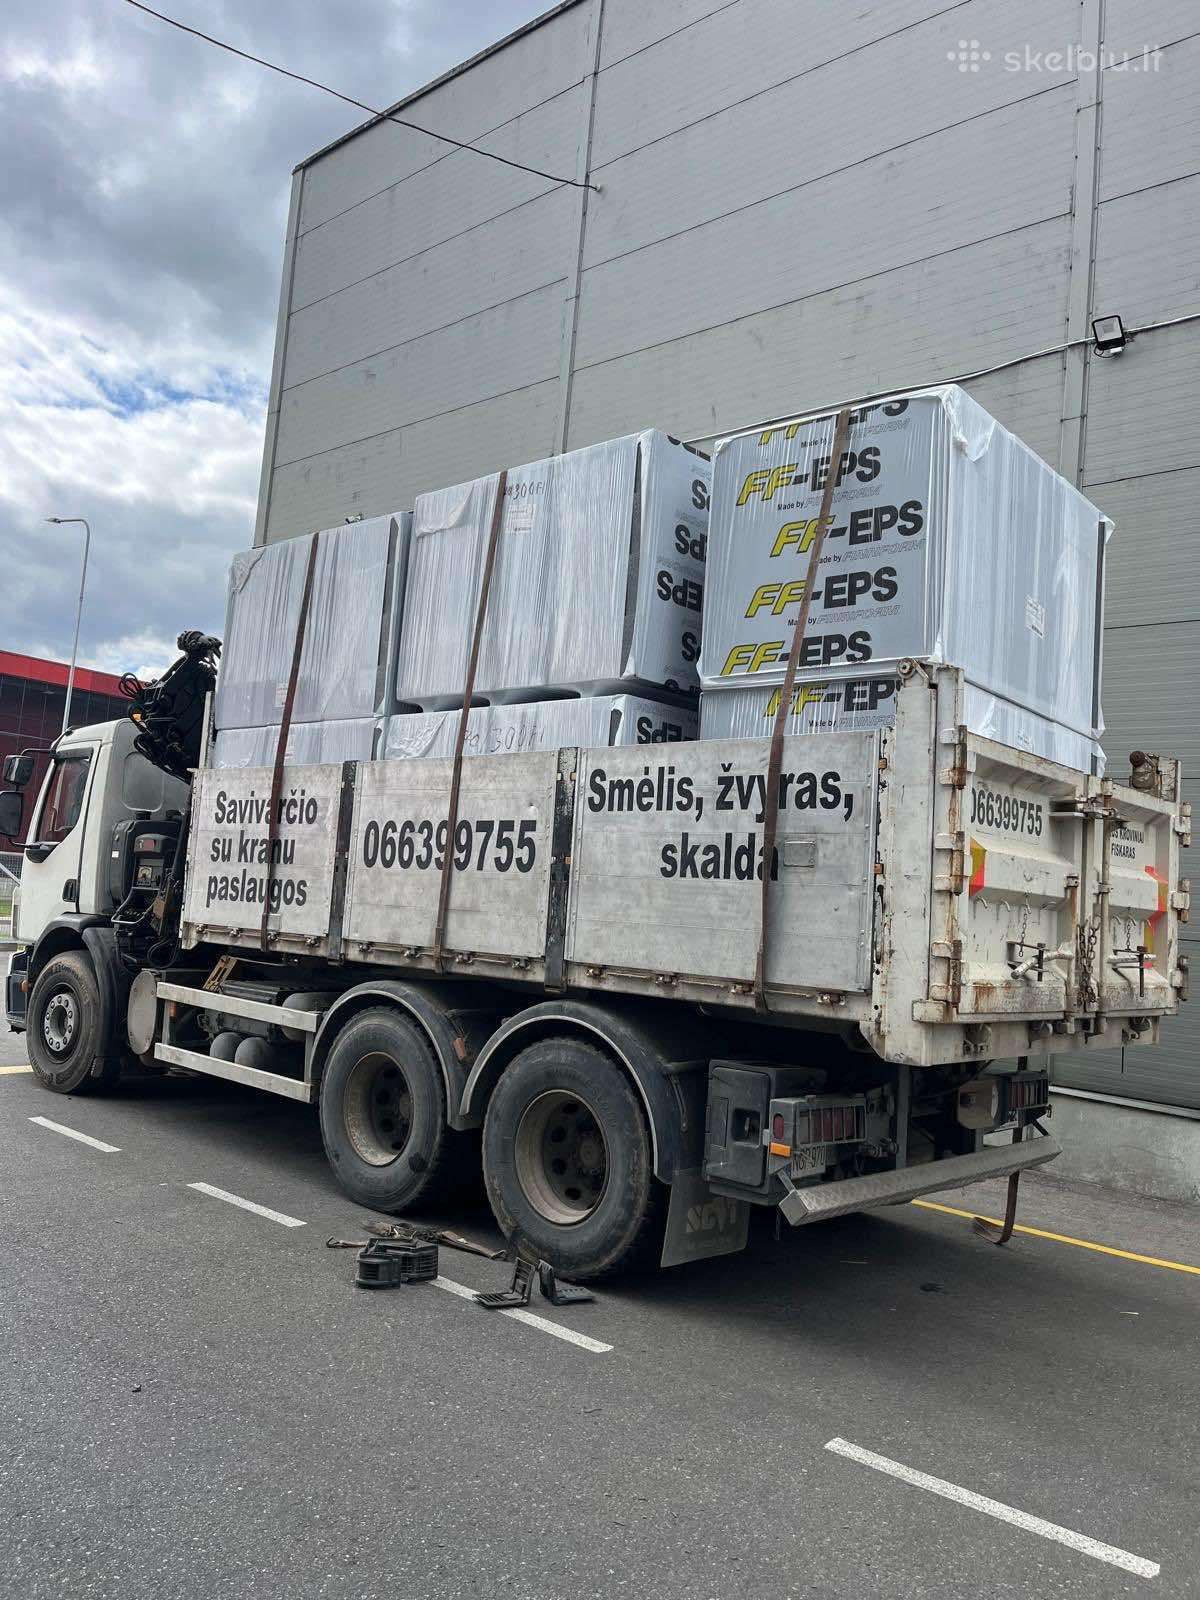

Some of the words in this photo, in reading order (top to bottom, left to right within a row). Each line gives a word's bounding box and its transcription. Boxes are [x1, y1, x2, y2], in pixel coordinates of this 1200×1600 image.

[736, 446, 881, 506] FF-EPS
[770, 500, 924, 557] FF-EPS
[744, 566, 899, 618] FF-EPS
[720, 630, 873, 676] FF-EPS
[214, 789, 318, 825] Savivarčio
[588, 766, 703, 822] Smėlis,
[715, 763, 854, 823] žvyras,
[210, 838, 232, 863] su
[237, 830, 296, 865] kranu
[363, 819, 537, 873] 066399755
[660, 832, 779, 881] skalda
[206, 869, 308, 914] paslaugos
